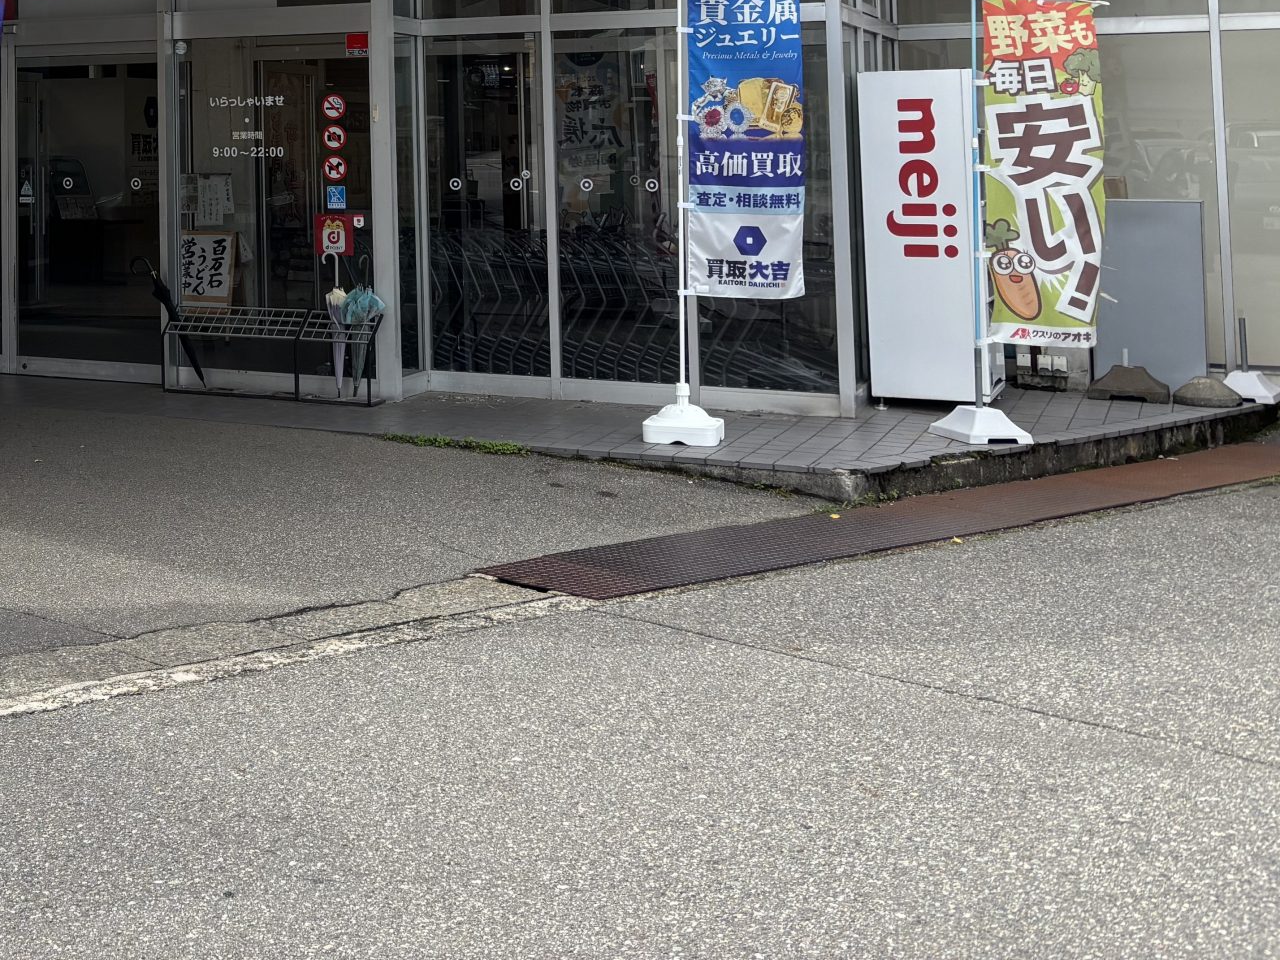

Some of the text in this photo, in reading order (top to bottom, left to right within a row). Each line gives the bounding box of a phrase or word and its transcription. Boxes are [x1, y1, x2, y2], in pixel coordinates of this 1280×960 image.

[695, 26, 800, 48] ジュエリー
[987, 10, 1094, 57] 野菜も
[702, 51, 733, 59] Precious
[734, 51, 760, 59] Metals
[989, 58, 1056, 94] 毎日
[209, 95, 285, 108] いらっしゃいませ
[231, 131, 263, 140] 営業時間
[694, 151, 804, 178] 高価買取
[886, 97, 959, 259] meiji
[696, 191, 801, 209] 査定・相談無料
[994, 102, 1100, 312] 安い!
[181, 236, 197, 297] 営業中
[192, 246, 209, 296] うどん
[207, 238, 227, 289] 百万石
[705, 258, 791, 281] 買取大吉
[1032, 330, 1092, 343] クスリのアオキ
